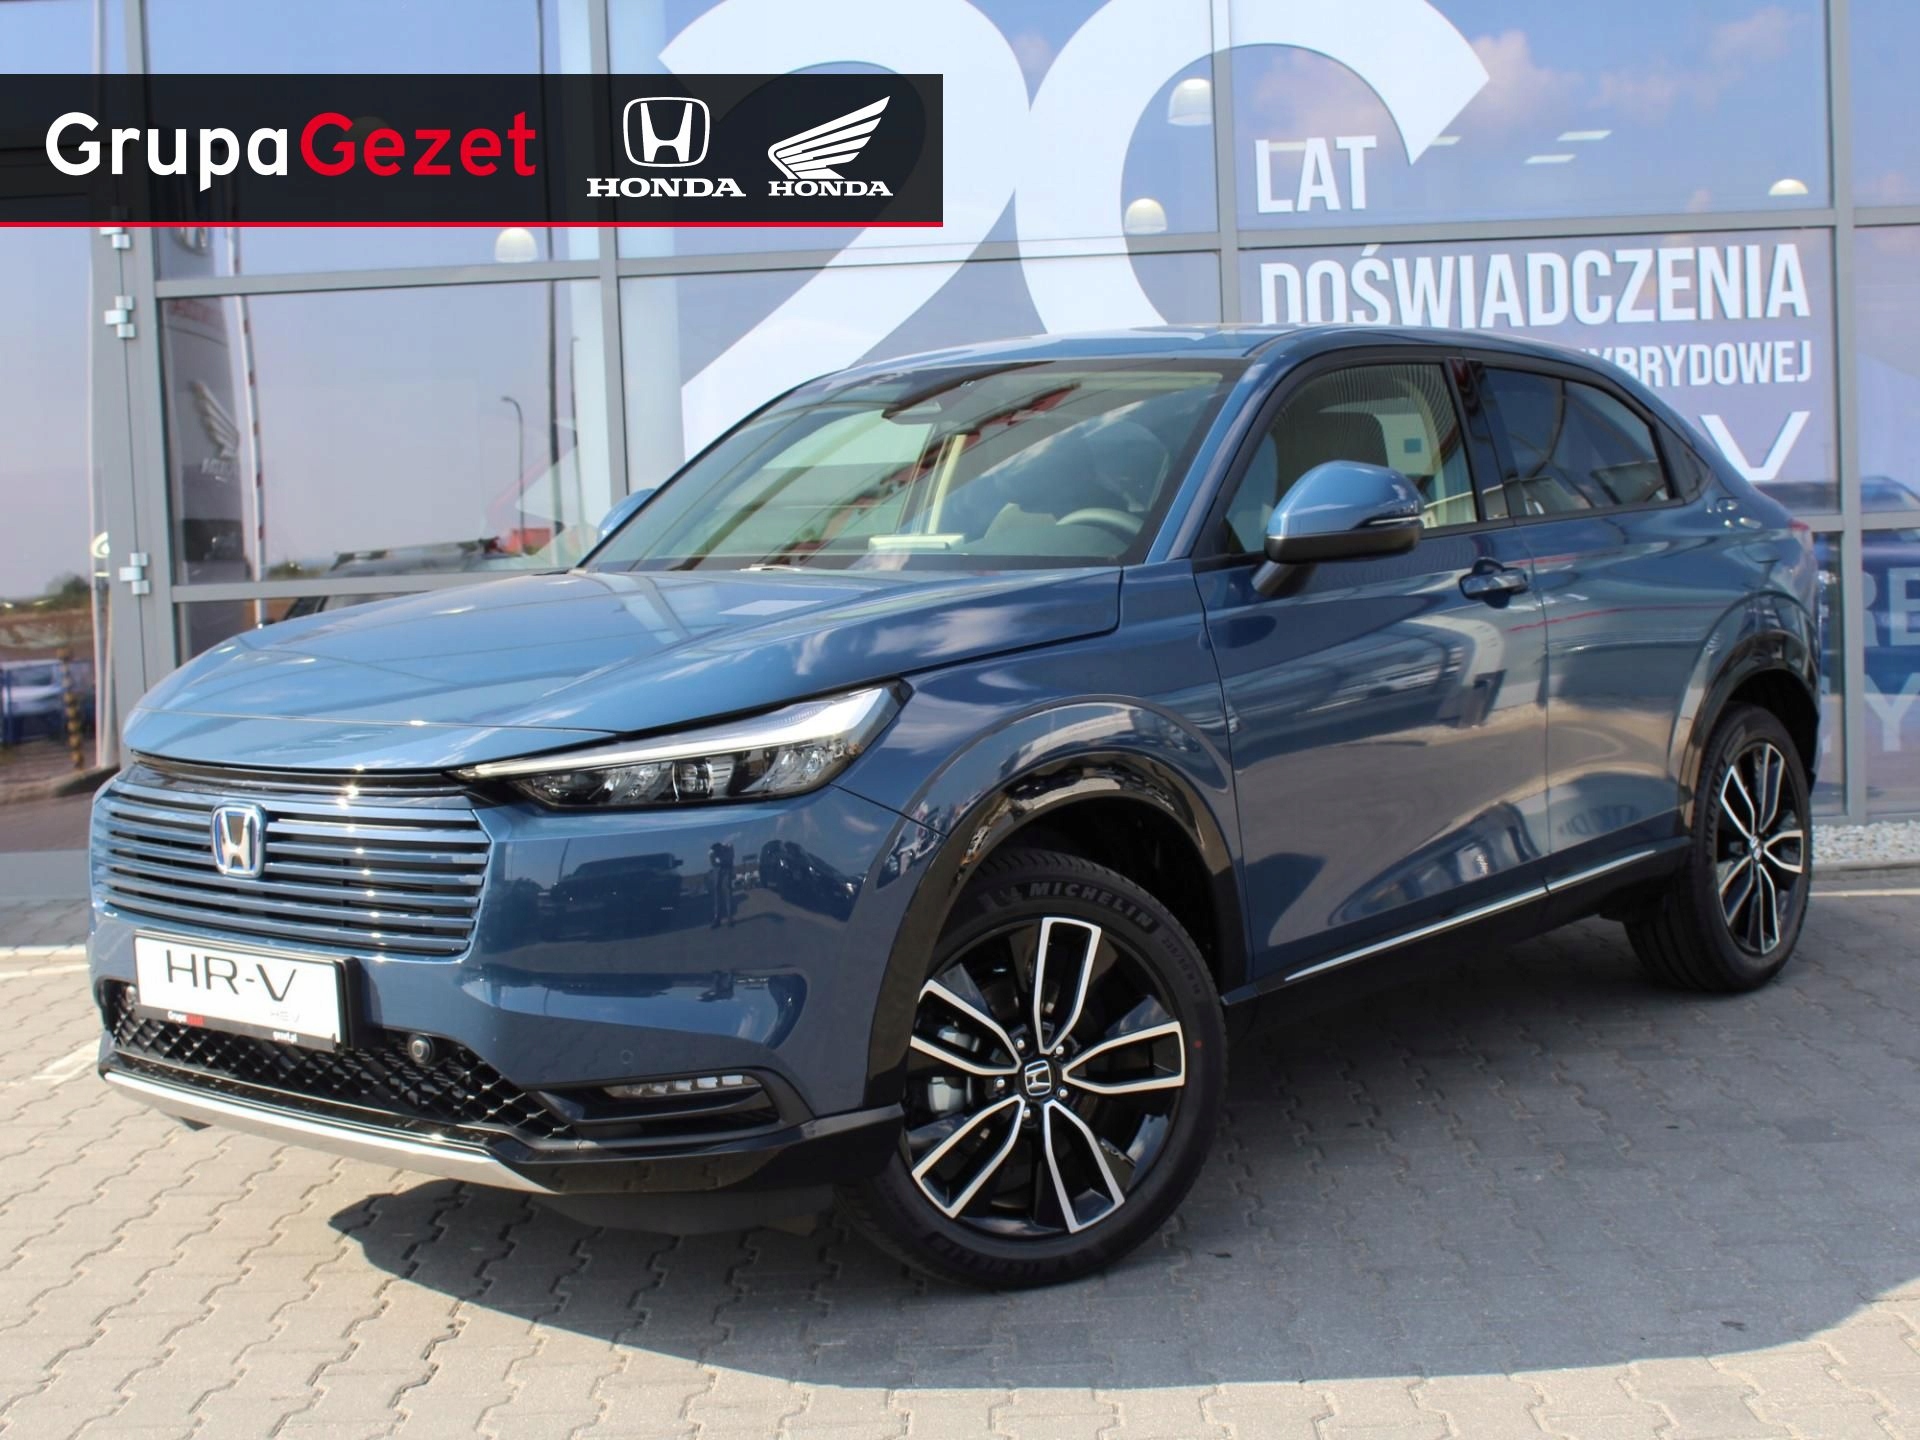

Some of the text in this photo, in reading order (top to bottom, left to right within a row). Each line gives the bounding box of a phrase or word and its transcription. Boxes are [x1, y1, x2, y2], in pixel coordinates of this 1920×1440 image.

[1255, 136, 1377, 214] LAT
[1260, 243, 1811, 329] DOŚWIADCZENIA
[1581, 340, 1812, 388] BRYDOWEJ
[1030, 881, 1153, 927] MICHELIN
[166, 949, 297, 1002] HR-V
